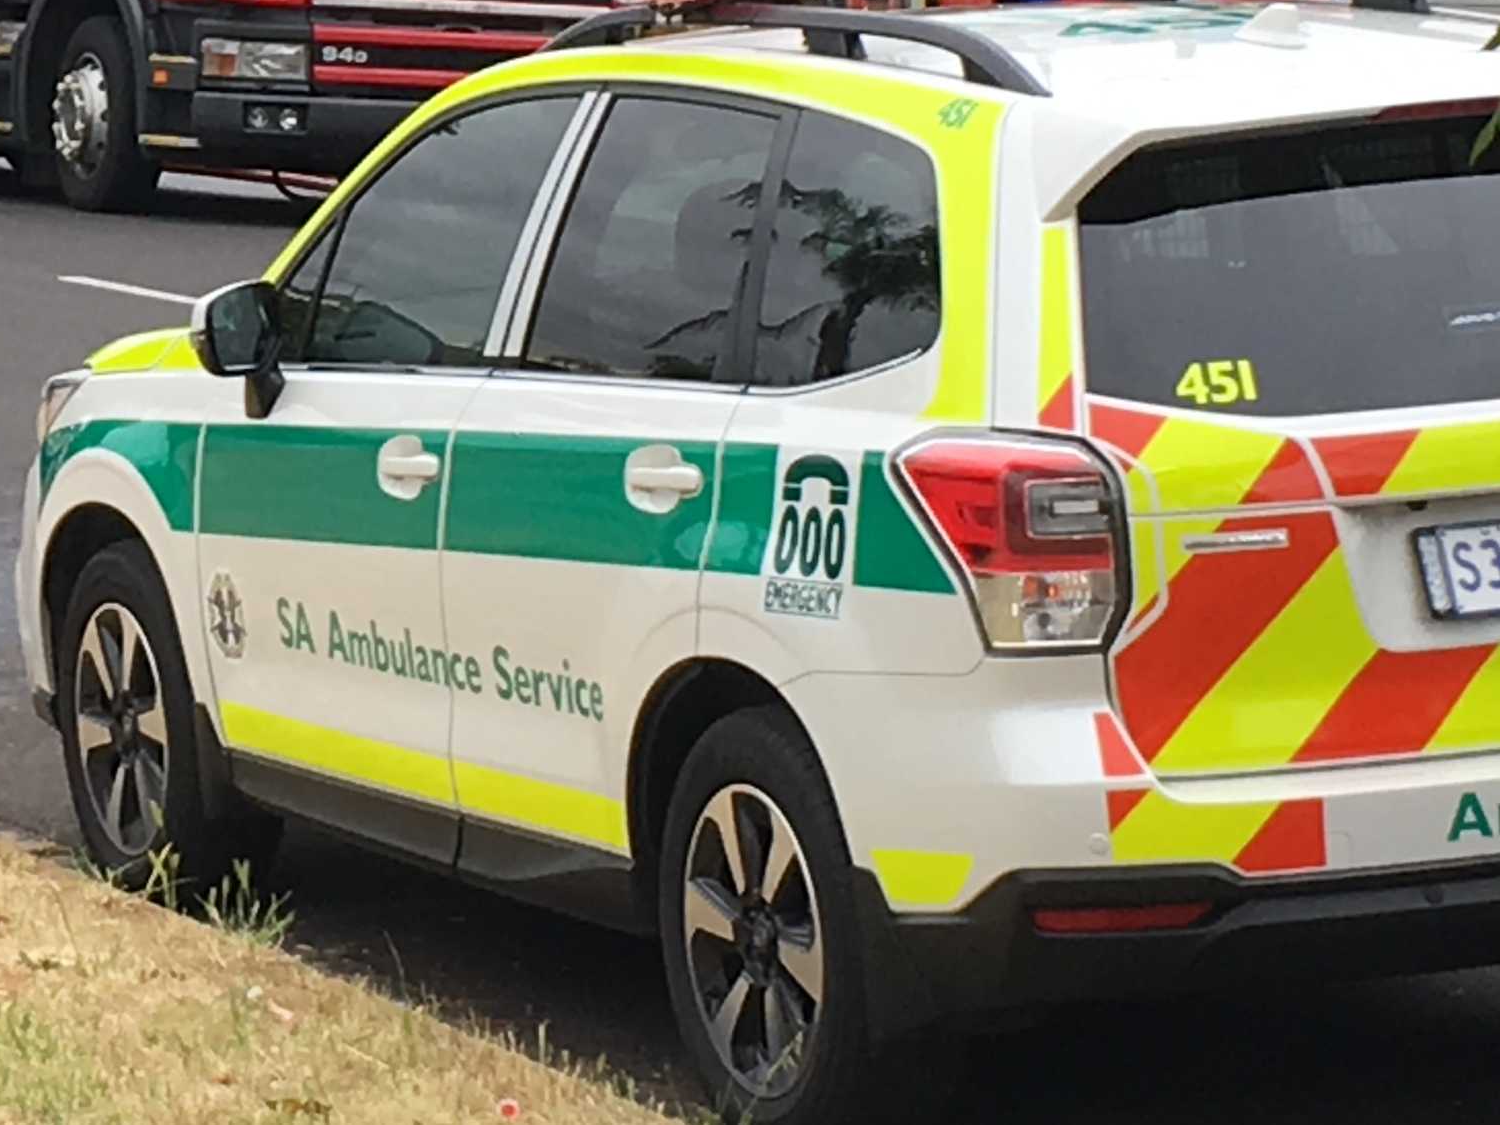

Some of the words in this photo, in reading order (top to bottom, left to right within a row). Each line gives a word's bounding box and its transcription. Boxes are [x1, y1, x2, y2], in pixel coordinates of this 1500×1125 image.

[937, 98, 980, 130] 451
[1175, 359, 1259, 405] 451
[773, 504, 847, 580] 000
[276, 596, 316, 654] SA
[328, 610, 482, 694] Ambulance
[492, 644, 604, 722] Service
